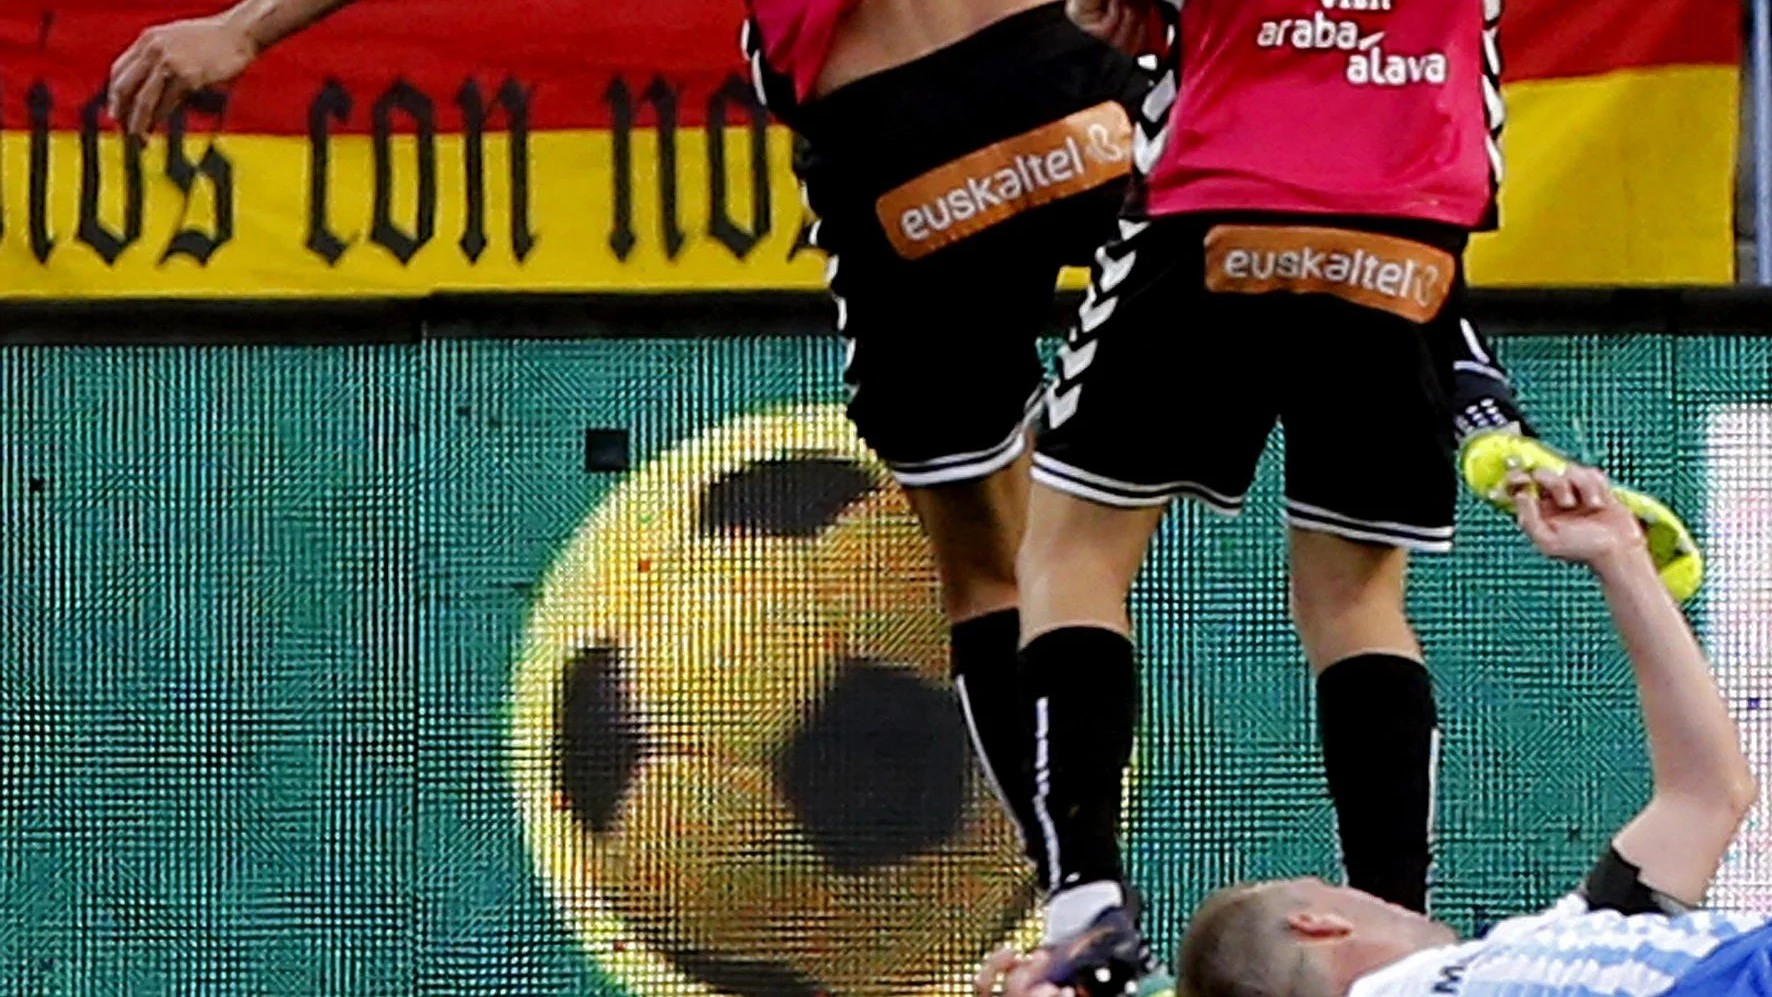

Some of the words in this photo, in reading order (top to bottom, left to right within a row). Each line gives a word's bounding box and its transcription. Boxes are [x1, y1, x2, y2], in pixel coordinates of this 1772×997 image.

[1257, 12, 1359, 49] araba
[603, 70, 835, 264] no
[900, 136, 1085, 243] euskaltel
[1223, 244, 1414, 301] euskaltel
